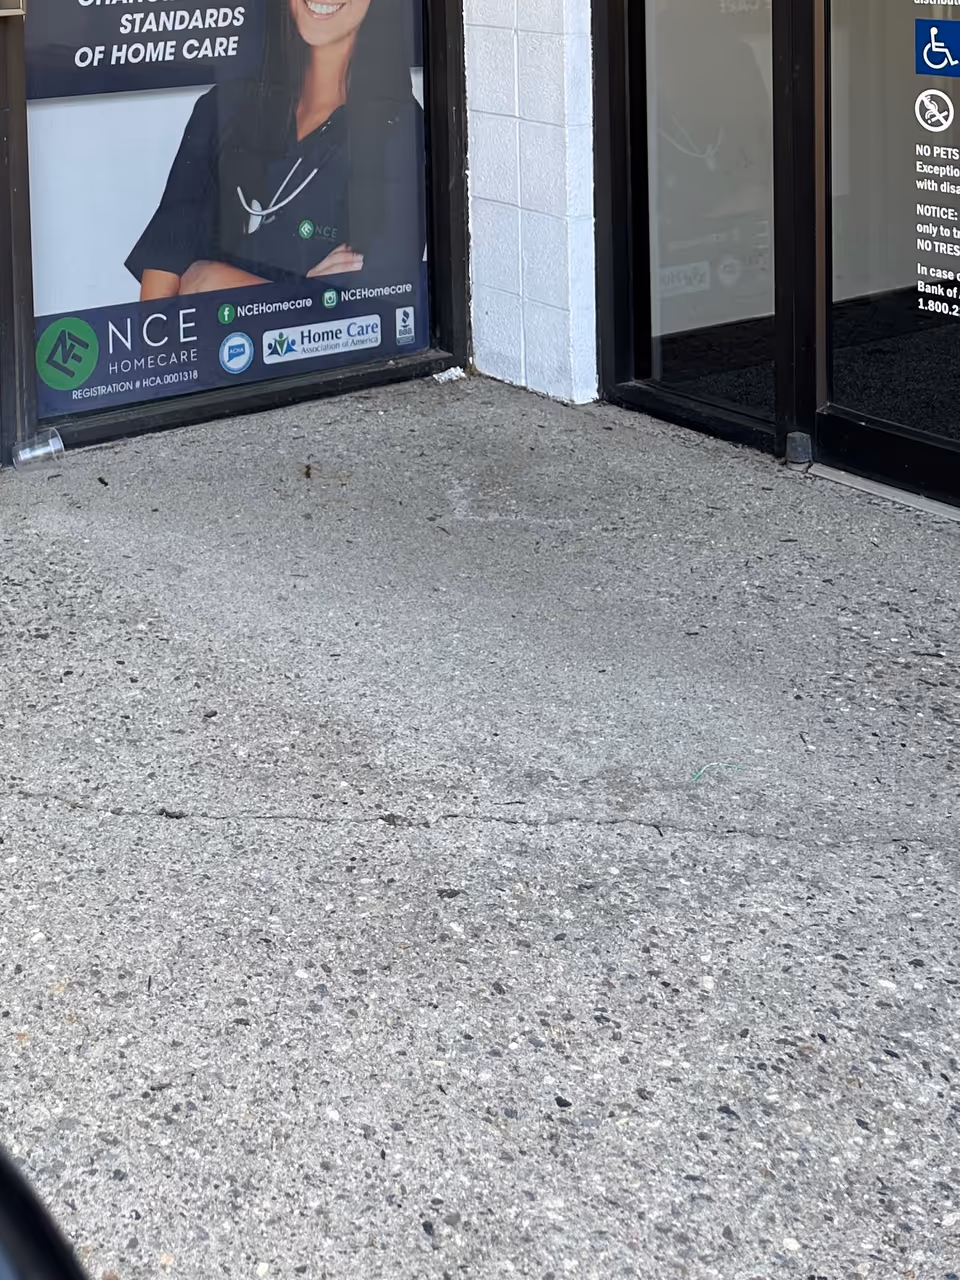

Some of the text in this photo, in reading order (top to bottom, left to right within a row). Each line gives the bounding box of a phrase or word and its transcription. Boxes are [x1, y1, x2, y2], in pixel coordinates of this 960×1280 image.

[119, 6, 245, 34] STANDARDS
[74, 36, 239, 68] OF HOME CARE
[915, 144, 959, 160] NO PETS
[916, 161, 960, 178] Exceptio
[916, 179, 938, 192] with
[916, 203, 958, 221] NOTICE:
[916, 223, 938, 237] only
[939, 225, 950, 237] to
[917, 238, 960, 257] NO TRES
[917, 263, 928, 276] In
[929, 267, 954, 280] case
[341, 283, 412, 302] NCEHomecare
[917, 280, 958, 299] Bank of
[237, 297, 313, 317] NCEHomecare
[108, 308, 198, 354] NCE
[300, 321, 378, 345] Home Care
[300, 336, 379, 355] Association of America
[109, 348, 198, 375] HOMECARE
[72, 381, 133, 400] REGISTRATION
[142, 370, 198, 388] HCA.0001318
